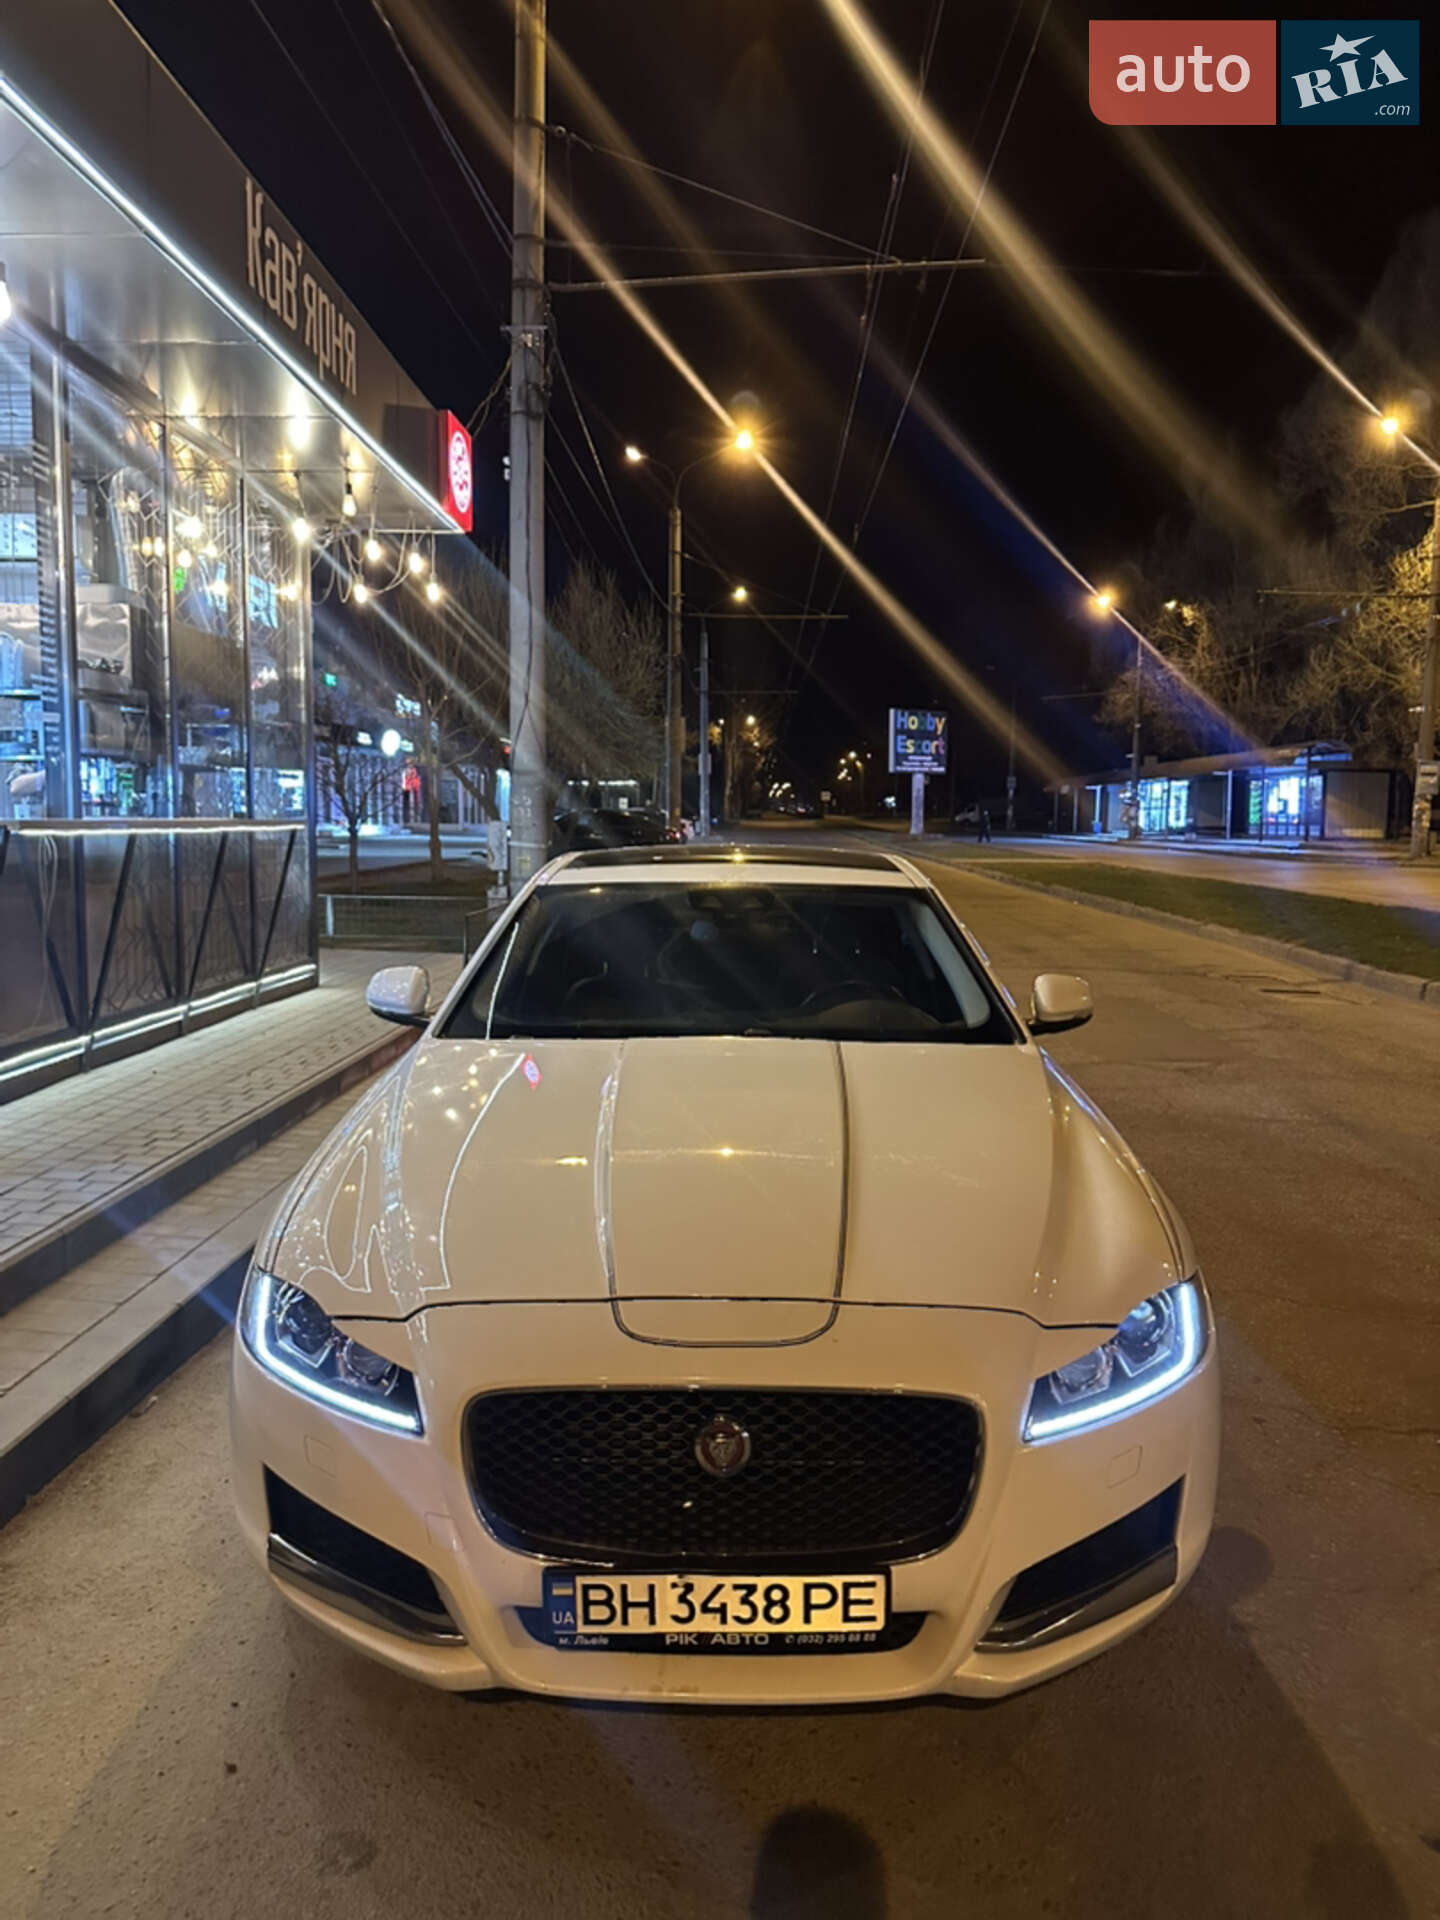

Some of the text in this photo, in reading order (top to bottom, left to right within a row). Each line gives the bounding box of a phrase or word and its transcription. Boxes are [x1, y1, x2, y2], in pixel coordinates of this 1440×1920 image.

[245, 176, 357, 396] Кав'ярня
[552, 1611, 574, 1624] UA
[581, 1581, 877, 1626] BH 3438 PE
